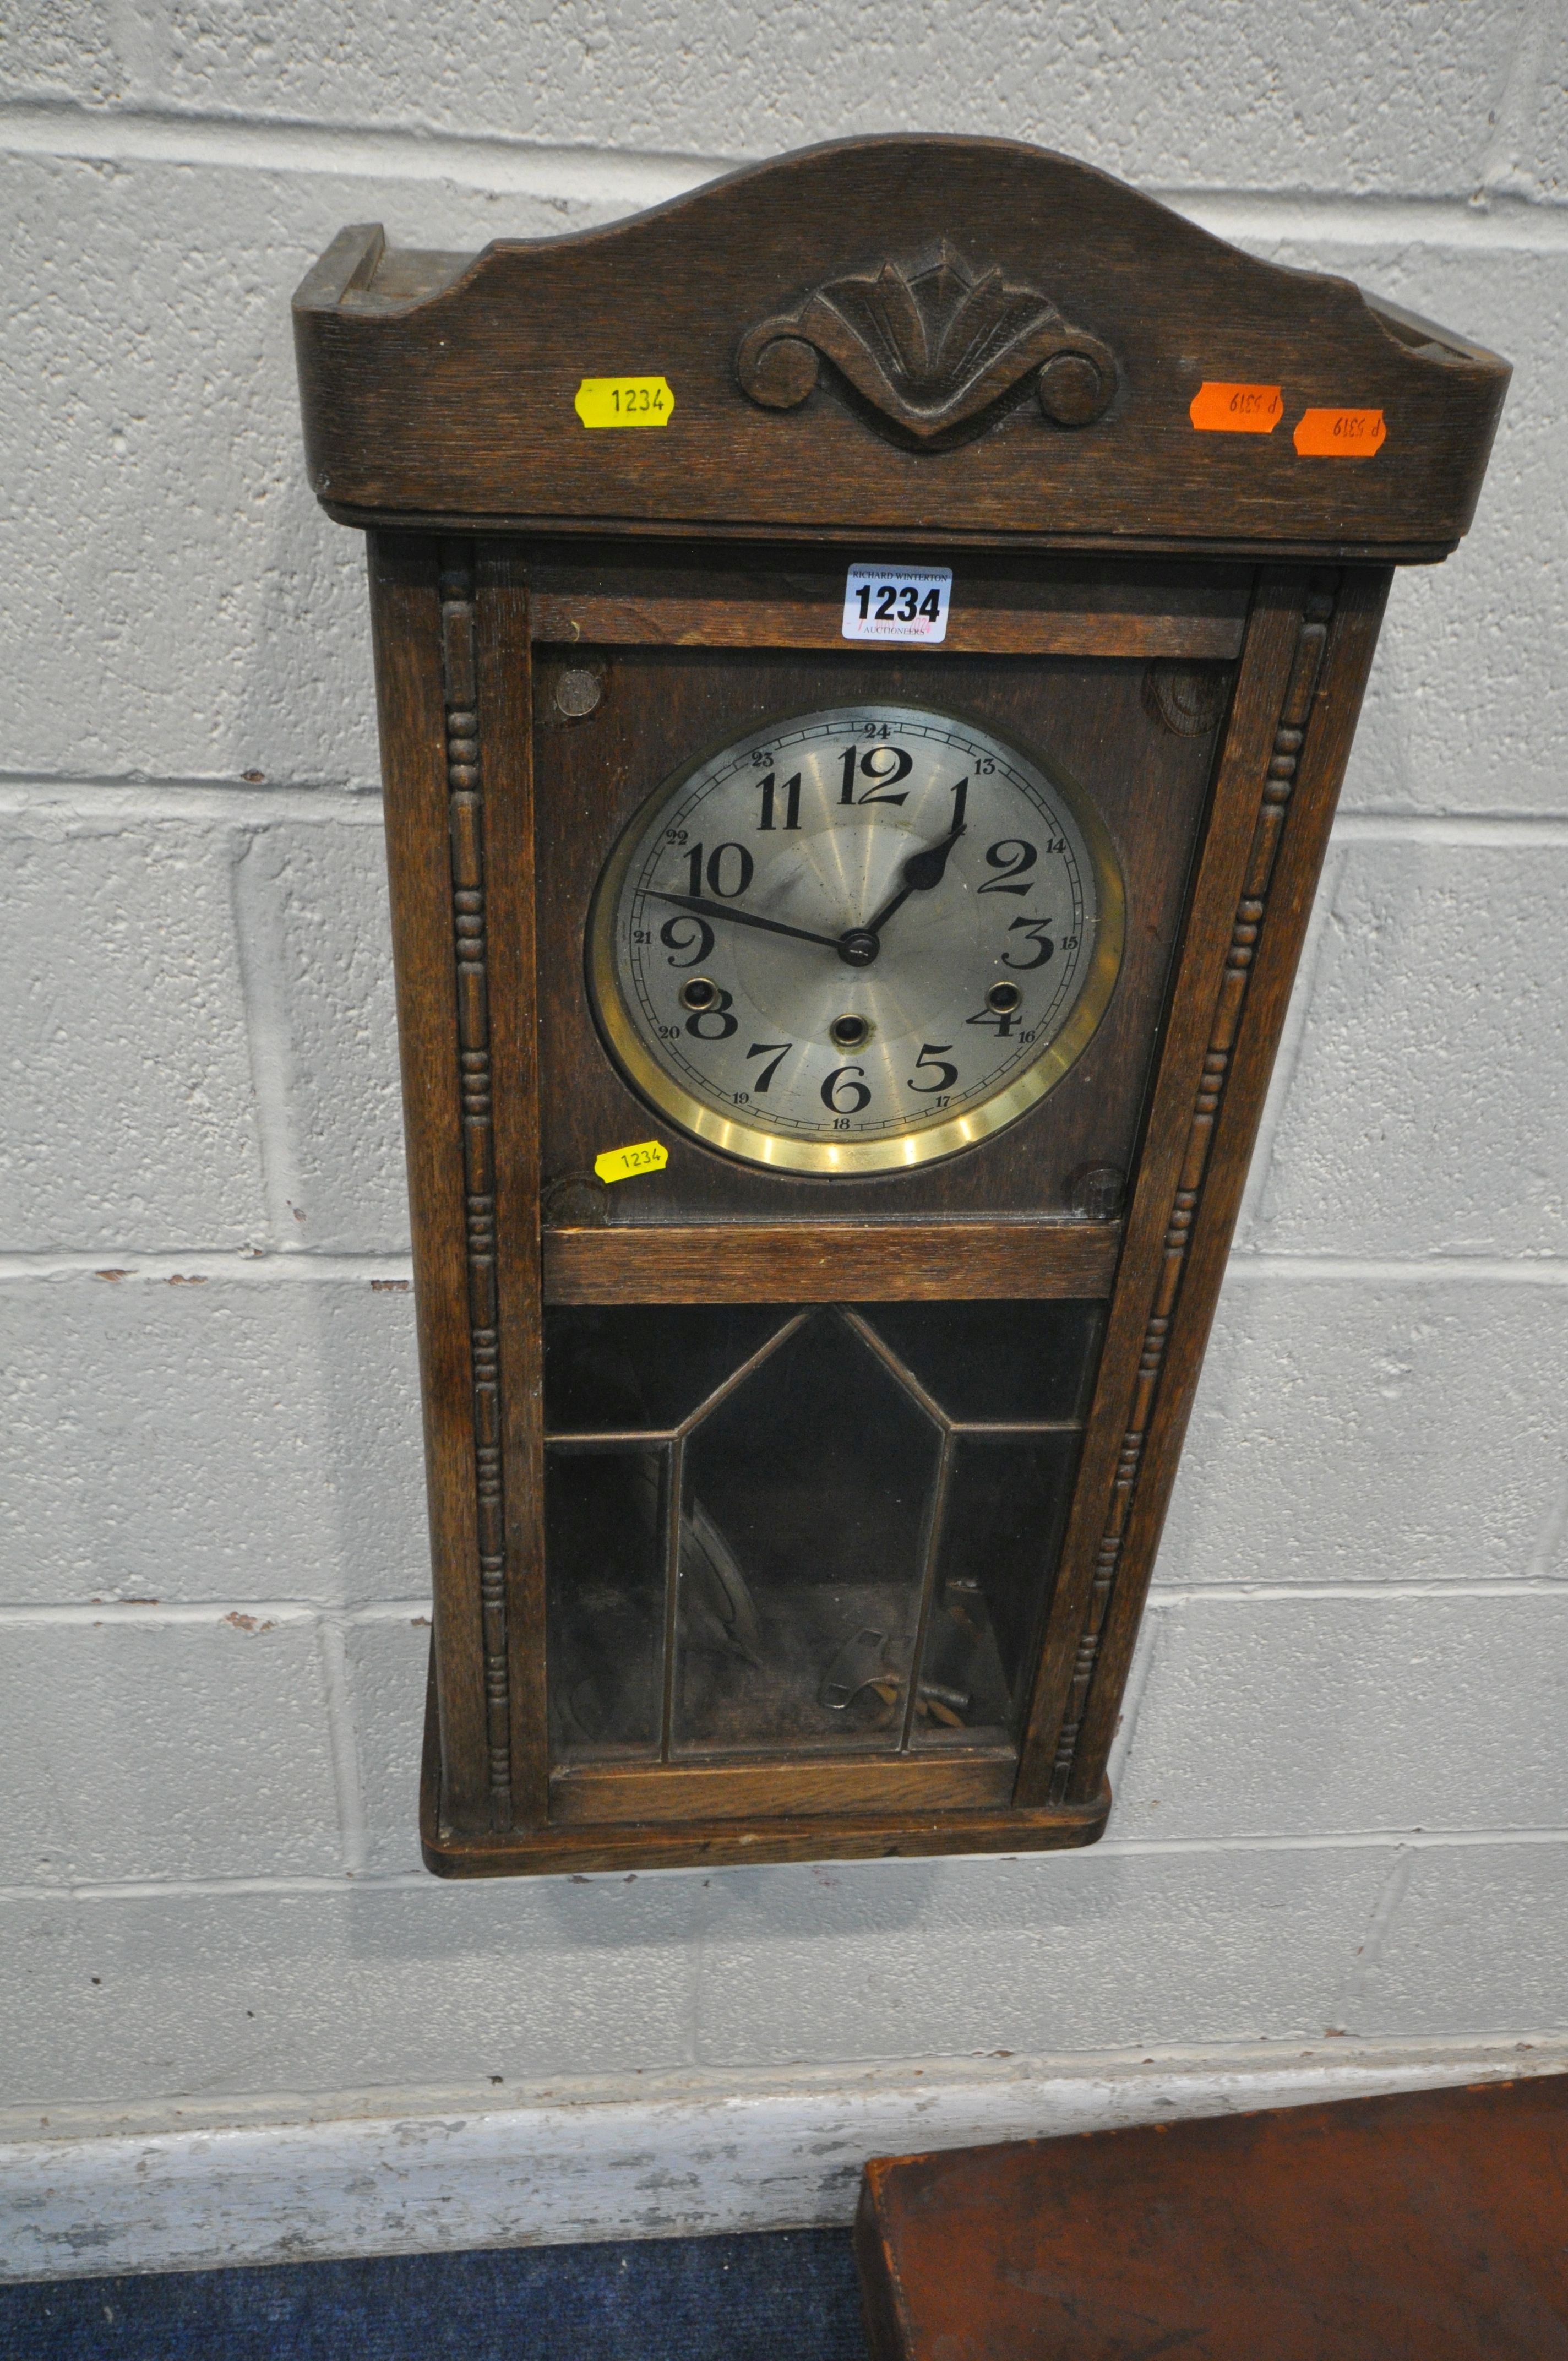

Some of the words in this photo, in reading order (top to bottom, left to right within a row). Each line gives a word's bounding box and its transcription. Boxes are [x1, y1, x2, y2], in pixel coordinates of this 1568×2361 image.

[612, 389, 664, 412] 1234
[853, 570, 894, 580] RICHARD
[895, 572, 948, 583] WINTERTON
[856, 585, 940, 623] 1234
[864, 626, 925, 636] AUCTIONEERS
[864, 723, 891, 739] 24
[752, 751, 774, 768] 23
[974, 758, 996, 775] 13
[837, 744, 913, 806] 12
[755, 771, 802, 830] 11
[948, 776, 969, 836] 1
[666, 829, 689, 845] 22
[1046, 837, 1066, 853] 14
[683, 842, 754, 898] 10
[977, 839, 1038, 896] 2
[633, 930, 652, 944] 21
[660, 915, 715, 969] 9
[1001, 916, 1054, 970] 3
[1060, 936, 1079, 950] 15
[685, 988, 738, 1040] 8
[659, 1026, 680, 1040] 20
[1018, 1030, 1036, 1043] 16
[746, 1043, 793, 1092] 7
[907, 1043, 959, 1093] 5
[732, 1092, 749, 1105] 19
[820, 1065, 872, 1114] 6
[935, 1096, 951, 1108] 17
[832, 1118, 851, 1130] 18
[621, 1148, 661, 1168] 1234
